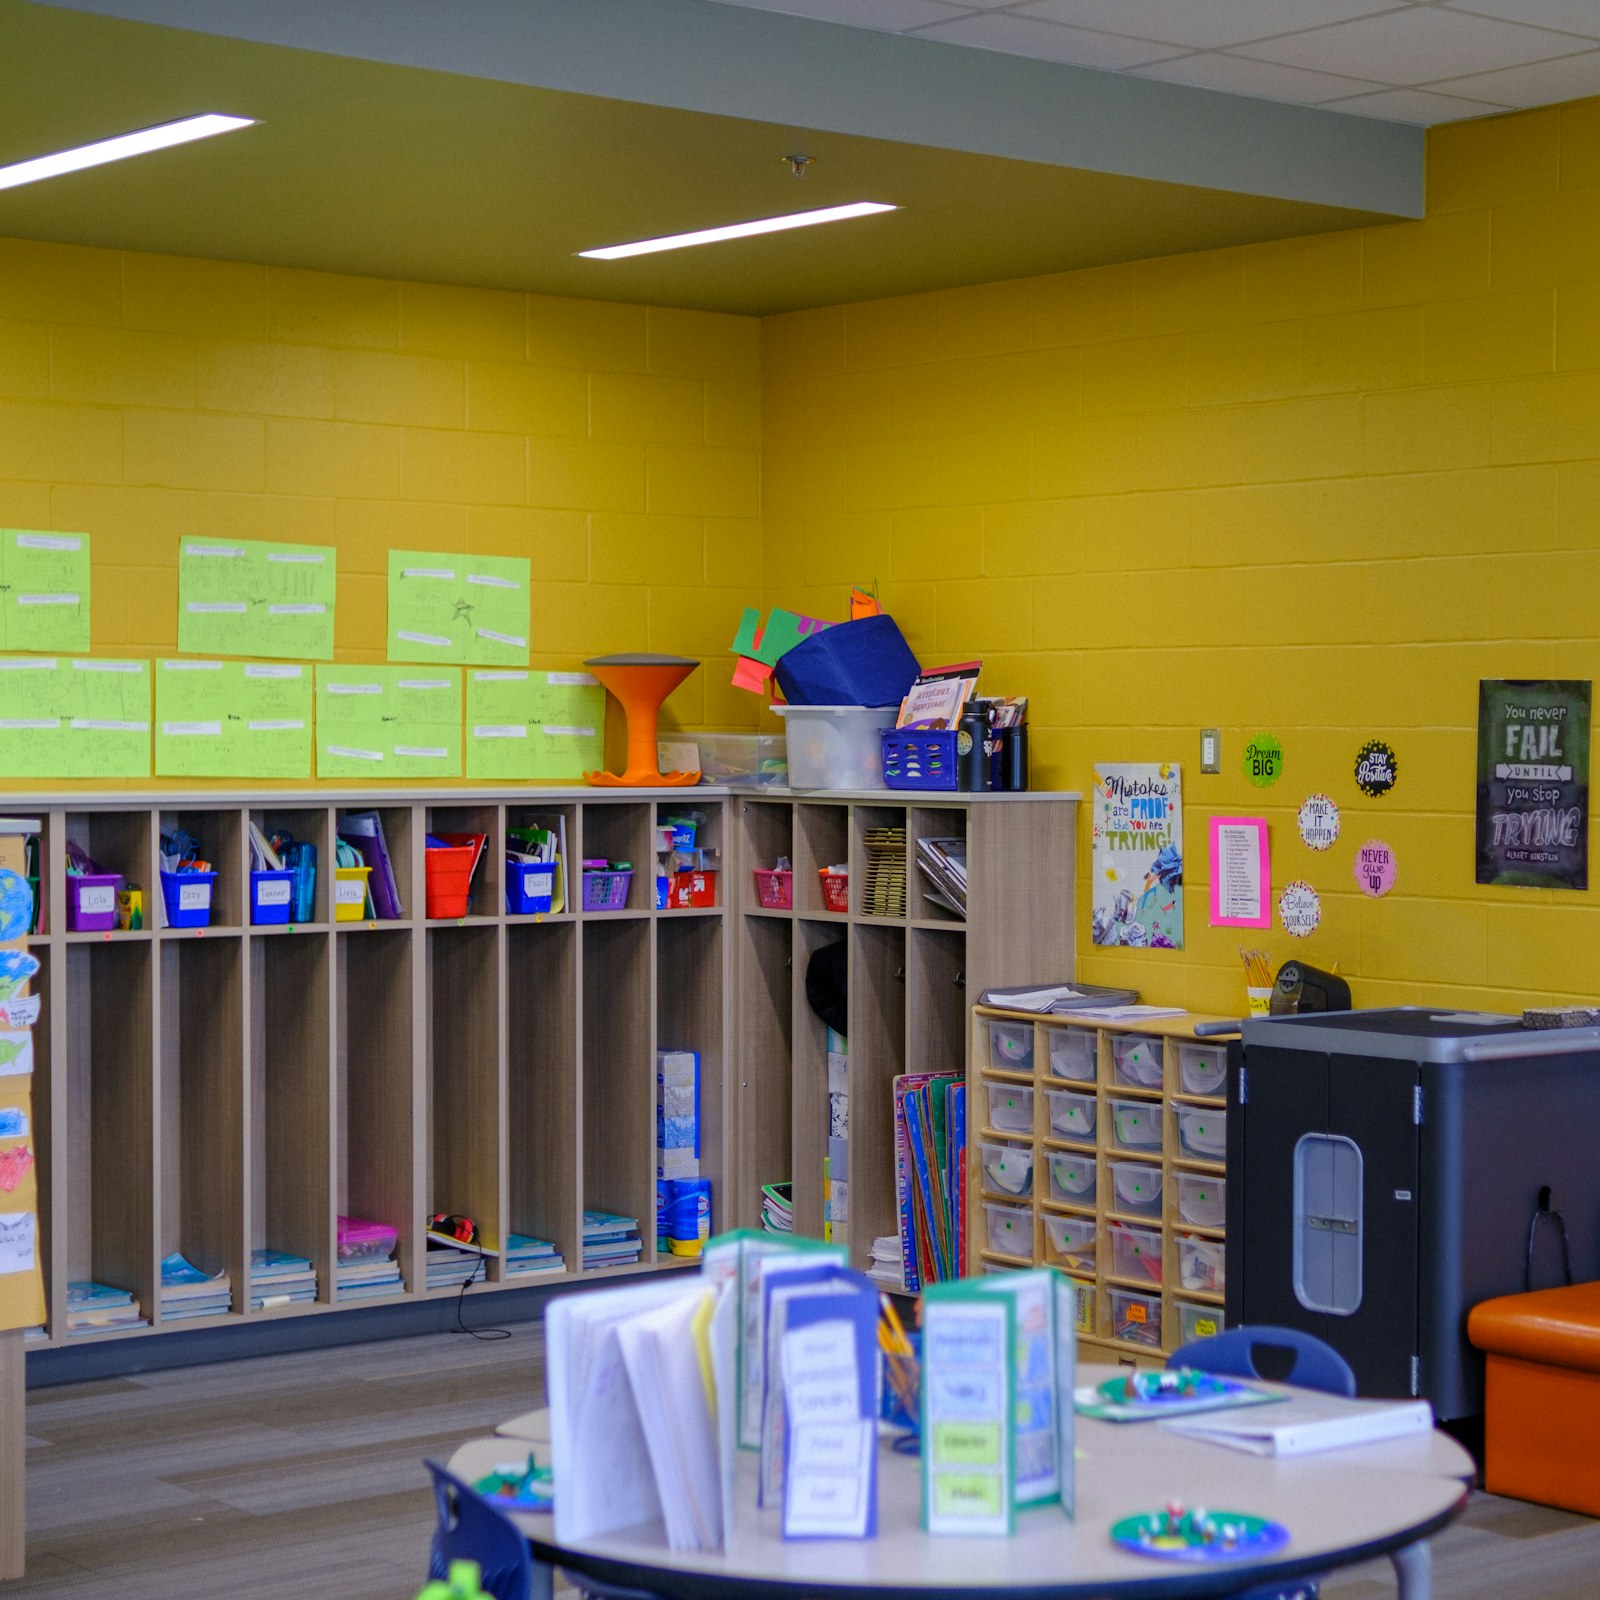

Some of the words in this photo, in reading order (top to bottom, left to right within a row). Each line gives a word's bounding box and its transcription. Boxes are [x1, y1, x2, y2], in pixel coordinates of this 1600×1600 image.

[916, 686, 951, 700] Acceptance
[912, 700, 946, 713] Superpower
[1504, 704, 1526, 719] You
[1530, 706, 1567, 720] never
[1505, 724, 1563, 761] FAIL
[1246, 744, 1281, 761] Dream
[1369, 752, 1388, 765] STAY
[1252, 759, 1274, 776] BIG
[1357, 760, 1393, 784] Positive
[1514, 766, 1553, 778] UNTIL
[1104, 775, 1168, 805] Mistakes
[1507, 786, 1529, 805] you
[1532, 784, 1560, 806] stop
[1112, 806, 1129, 817] are
[1131, 797, 1168, 819] PROOF
[1309, 802, 1329, 815] MAKE
[1113, 819, 1129, 830] that
[1129, 820, 1147, 831] YOU
[1314, 815, 1323, 828] IT
[1492, 806, 1581, 847] TRYING
[1105, 822, 1171, 851] TRYING!
[1305, 828, 1332, 841] HAPPEN
[1361, 849, 1389, 864] NEVER
[1506, 850, 1529, 860] ALBERT
[1530, 852, 1559, 862] EINSTEIN
[1362, 863, 1385, 879] give
[261, 887, 287, 898] Tanner
[339, 887, 357, 898] Livia
[88, 895, 107, 906] Lola
[1283, 892, 1315, 910] Believe
[1284, 914, 1316, 928] YOURSELF
